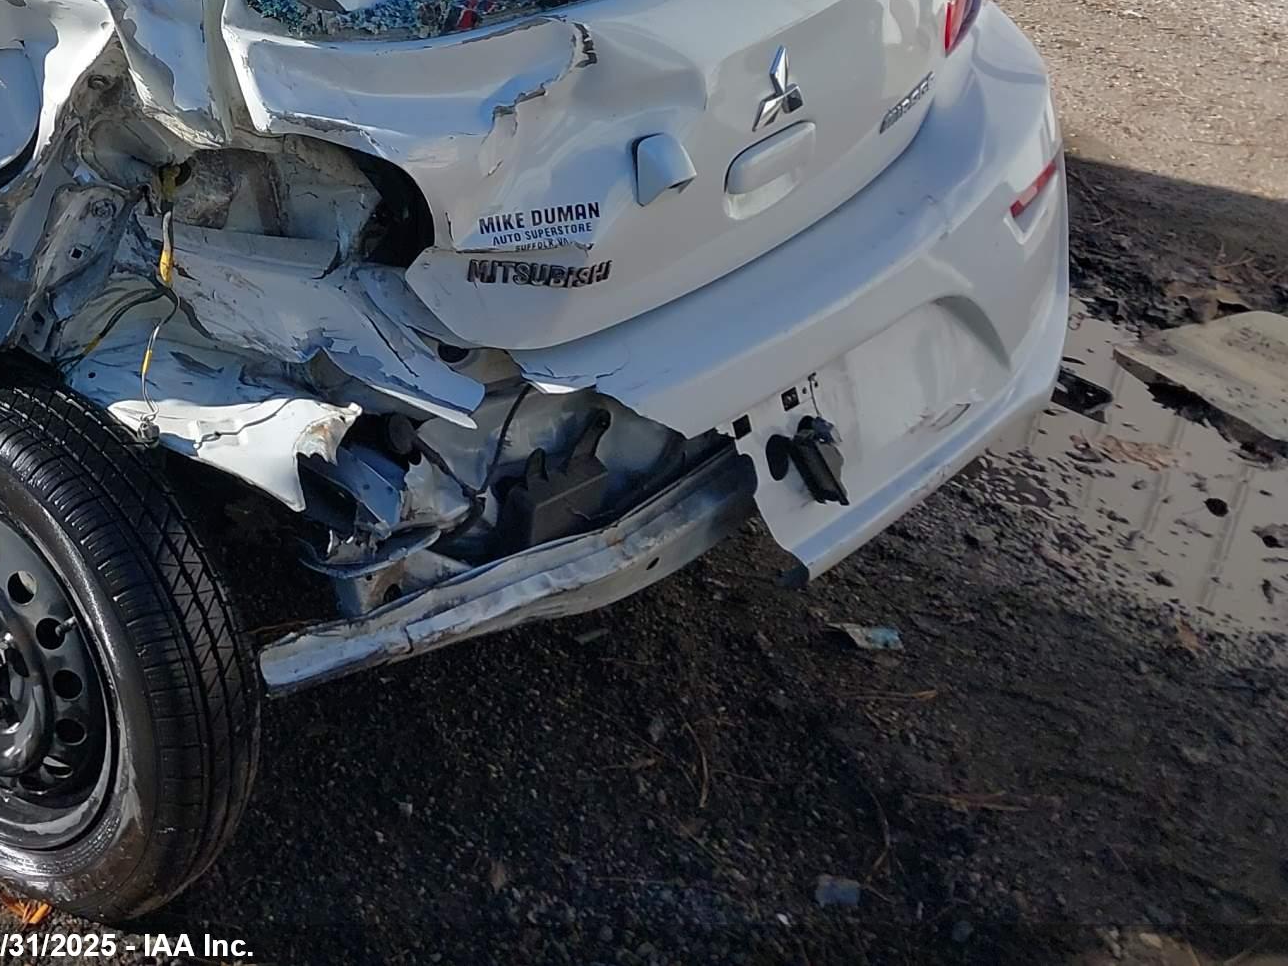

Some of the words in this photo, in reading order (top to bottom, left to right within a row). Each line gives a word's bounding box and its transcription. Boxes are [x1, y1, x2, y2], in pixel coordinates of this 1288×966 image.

[479, 212, 525, 235] MIKE
[531, 201, 600, 227] DUMAN
[493, 233, 522, 246] AUTO
[525, 222, 593, 241] SUPERSTORE
[467, 259, 612, 288] MITSUBISHI
